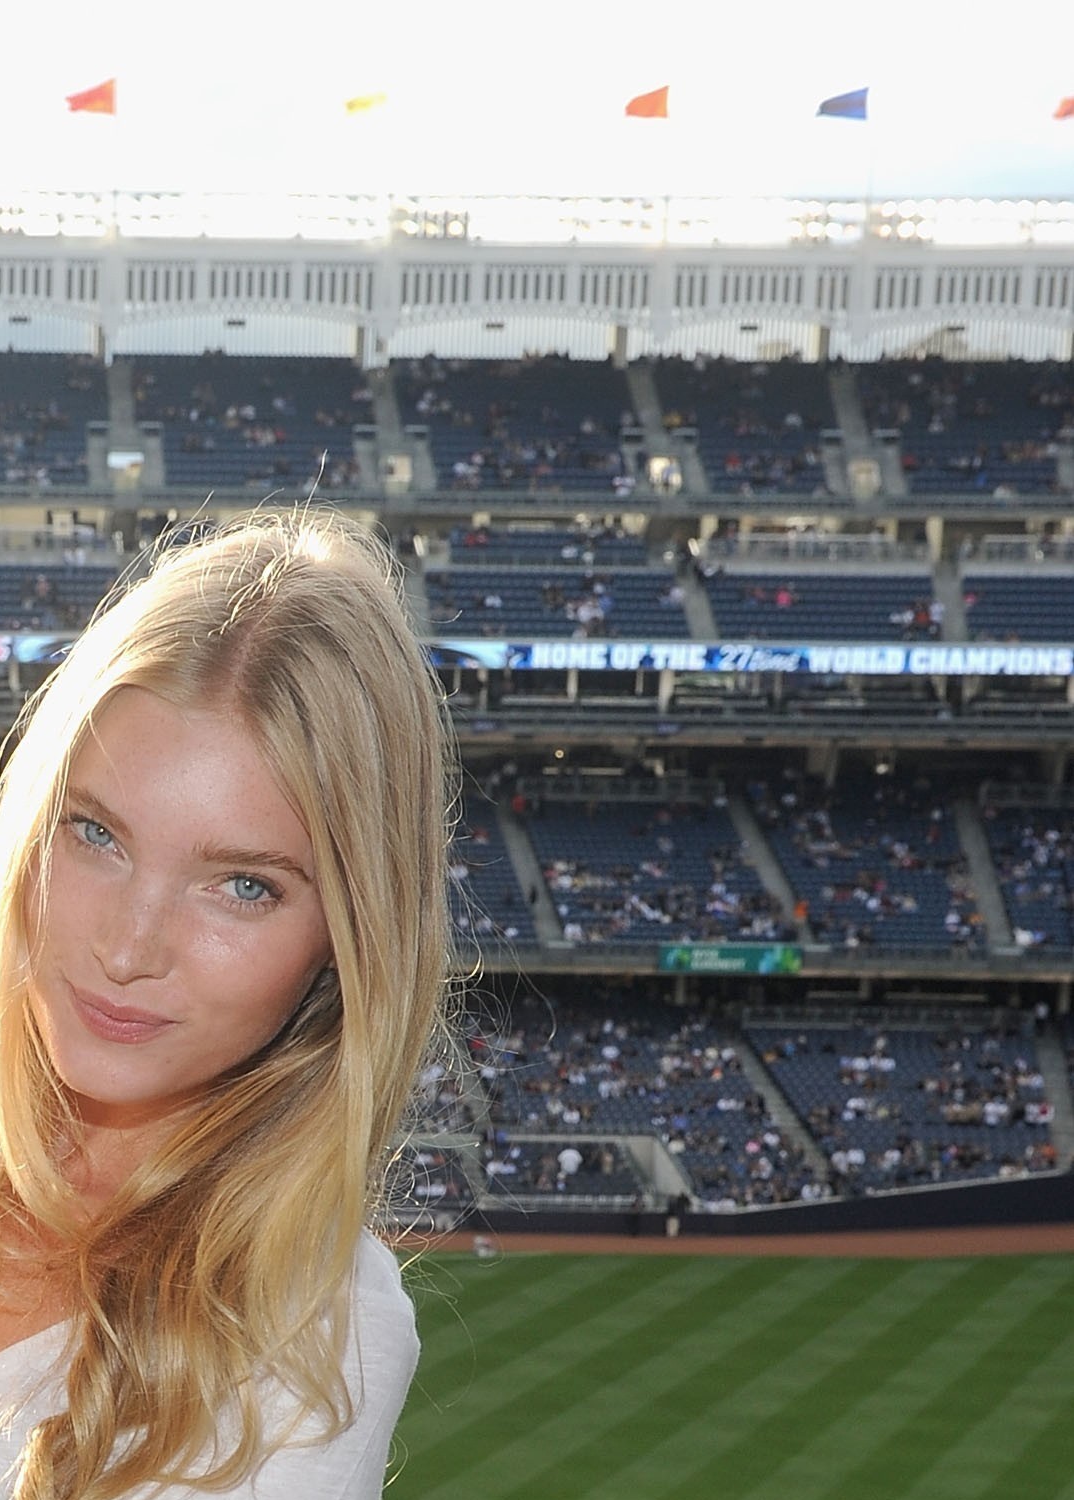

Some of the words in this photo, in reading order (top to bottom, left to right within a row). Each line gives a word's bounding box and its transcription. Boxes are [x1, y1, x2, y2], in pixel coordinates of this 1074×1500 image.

[531, 643, 607, 669] HOME
[610, 644, 648, 669] OF
[649, 644, 708, 670] THE
[718, 644, 753, 671] 27
[808, 647, 905, 673] WORLD
[907, 647, 1073, 674] CHAMPIONS
